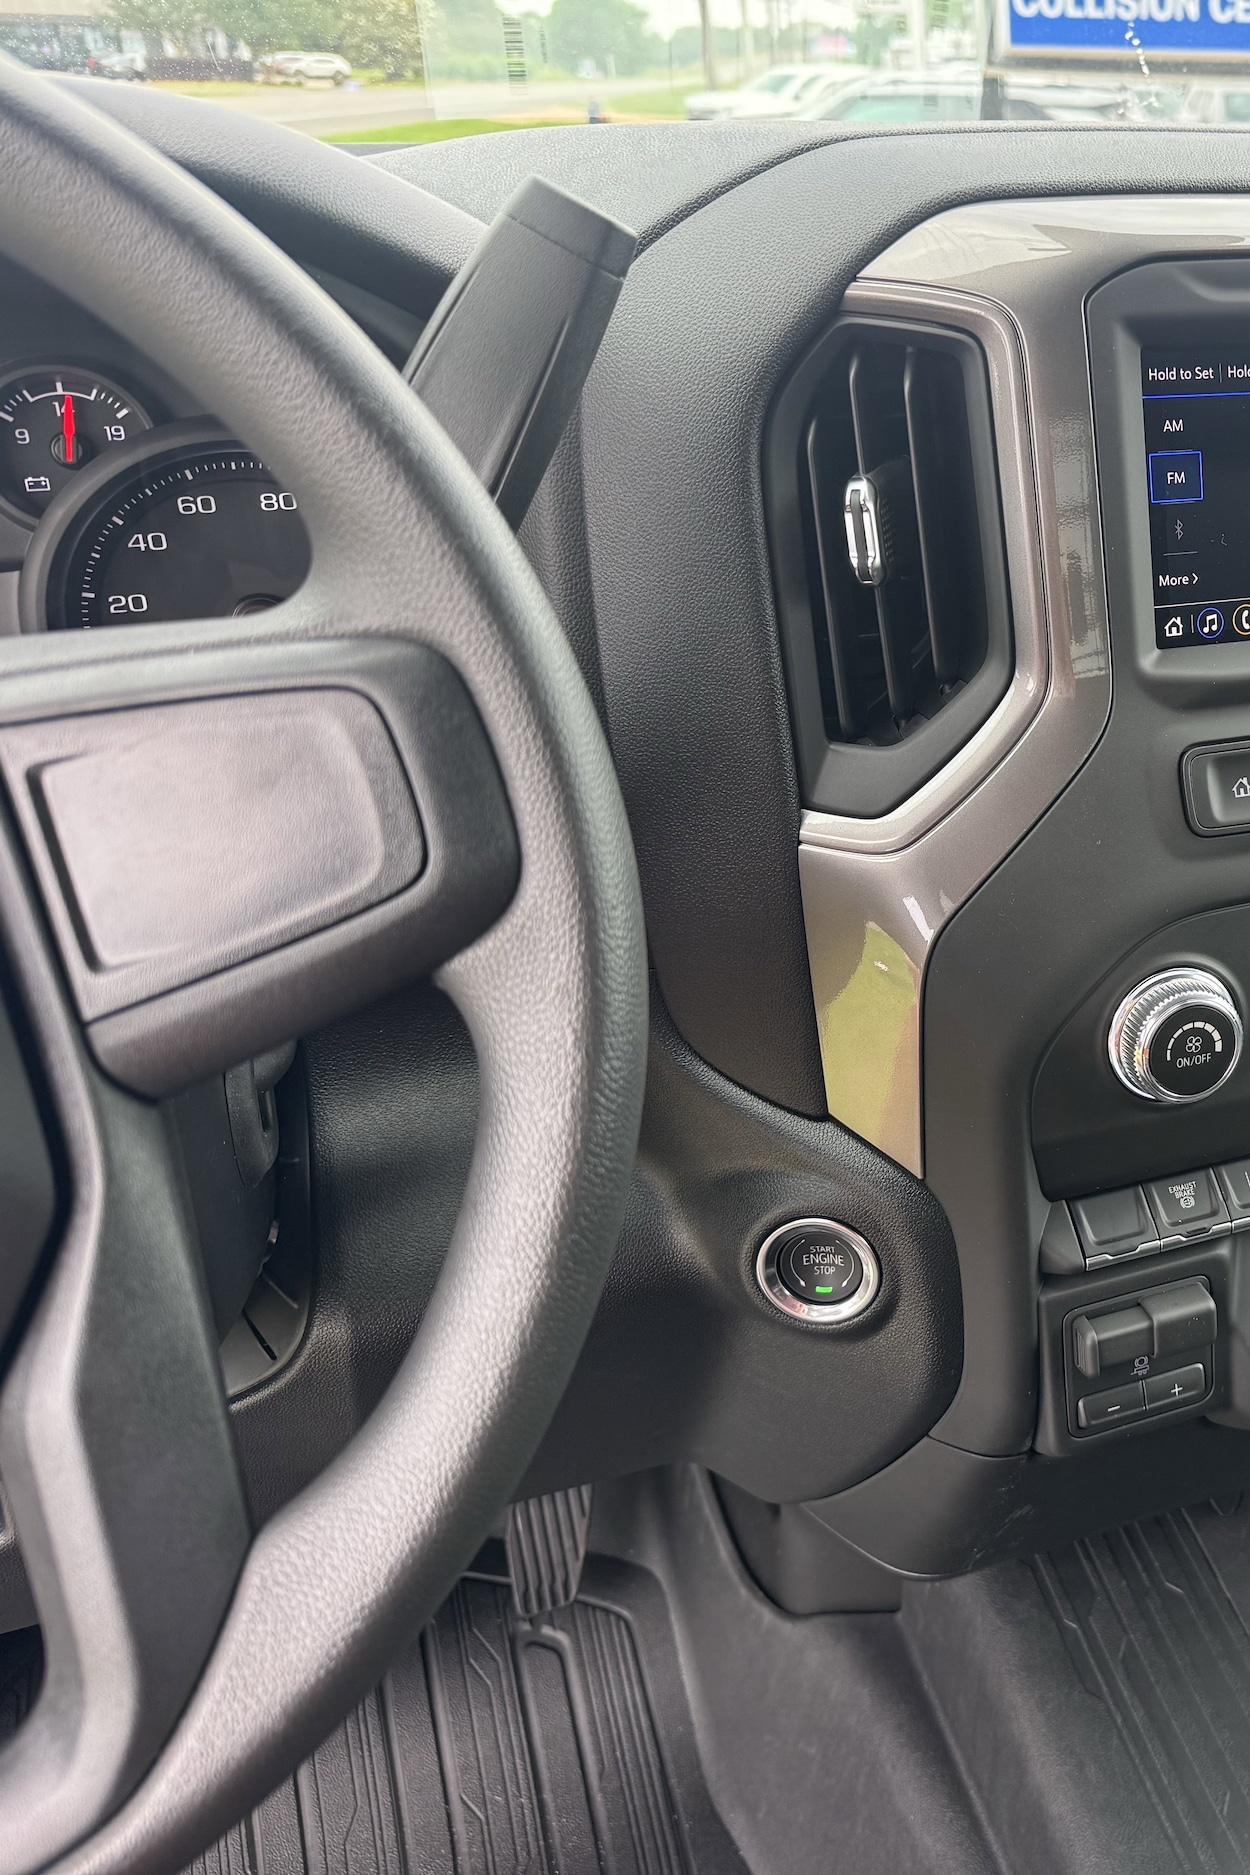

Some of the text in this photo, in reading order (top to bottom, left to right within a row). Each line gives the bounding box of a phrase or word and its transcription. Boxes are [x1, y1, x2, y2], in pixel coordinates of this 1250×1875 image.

[1012, 0, 1200, 21] COLLISION
[1149, 367, 1214, 381] Hold to Set
[1163, 419, 1184, 432] AM
[14, 428, 31, 445] 9
[103, 425, 126, 441] 19
[1167, 472, 1186, 484] FM
[176, 495, 217, 515] 60
[259, 493, 298, 511] 80
[127, 532, 168, 552] 40
[1159, 573, 1189, 586] More
[108, 593, 148, 614] 20
[1176, 1053, 1212, 1069] ON/OFF
[1168, 1181, 1197, 1194] EXHAUST
[1174, 1189, 1196, 1199] BRAKE
[809, 1245, 835, 1253] START
[802, 1253, 845, 1266] ENGINE
[814, 1265, 836, 1275] STOP
